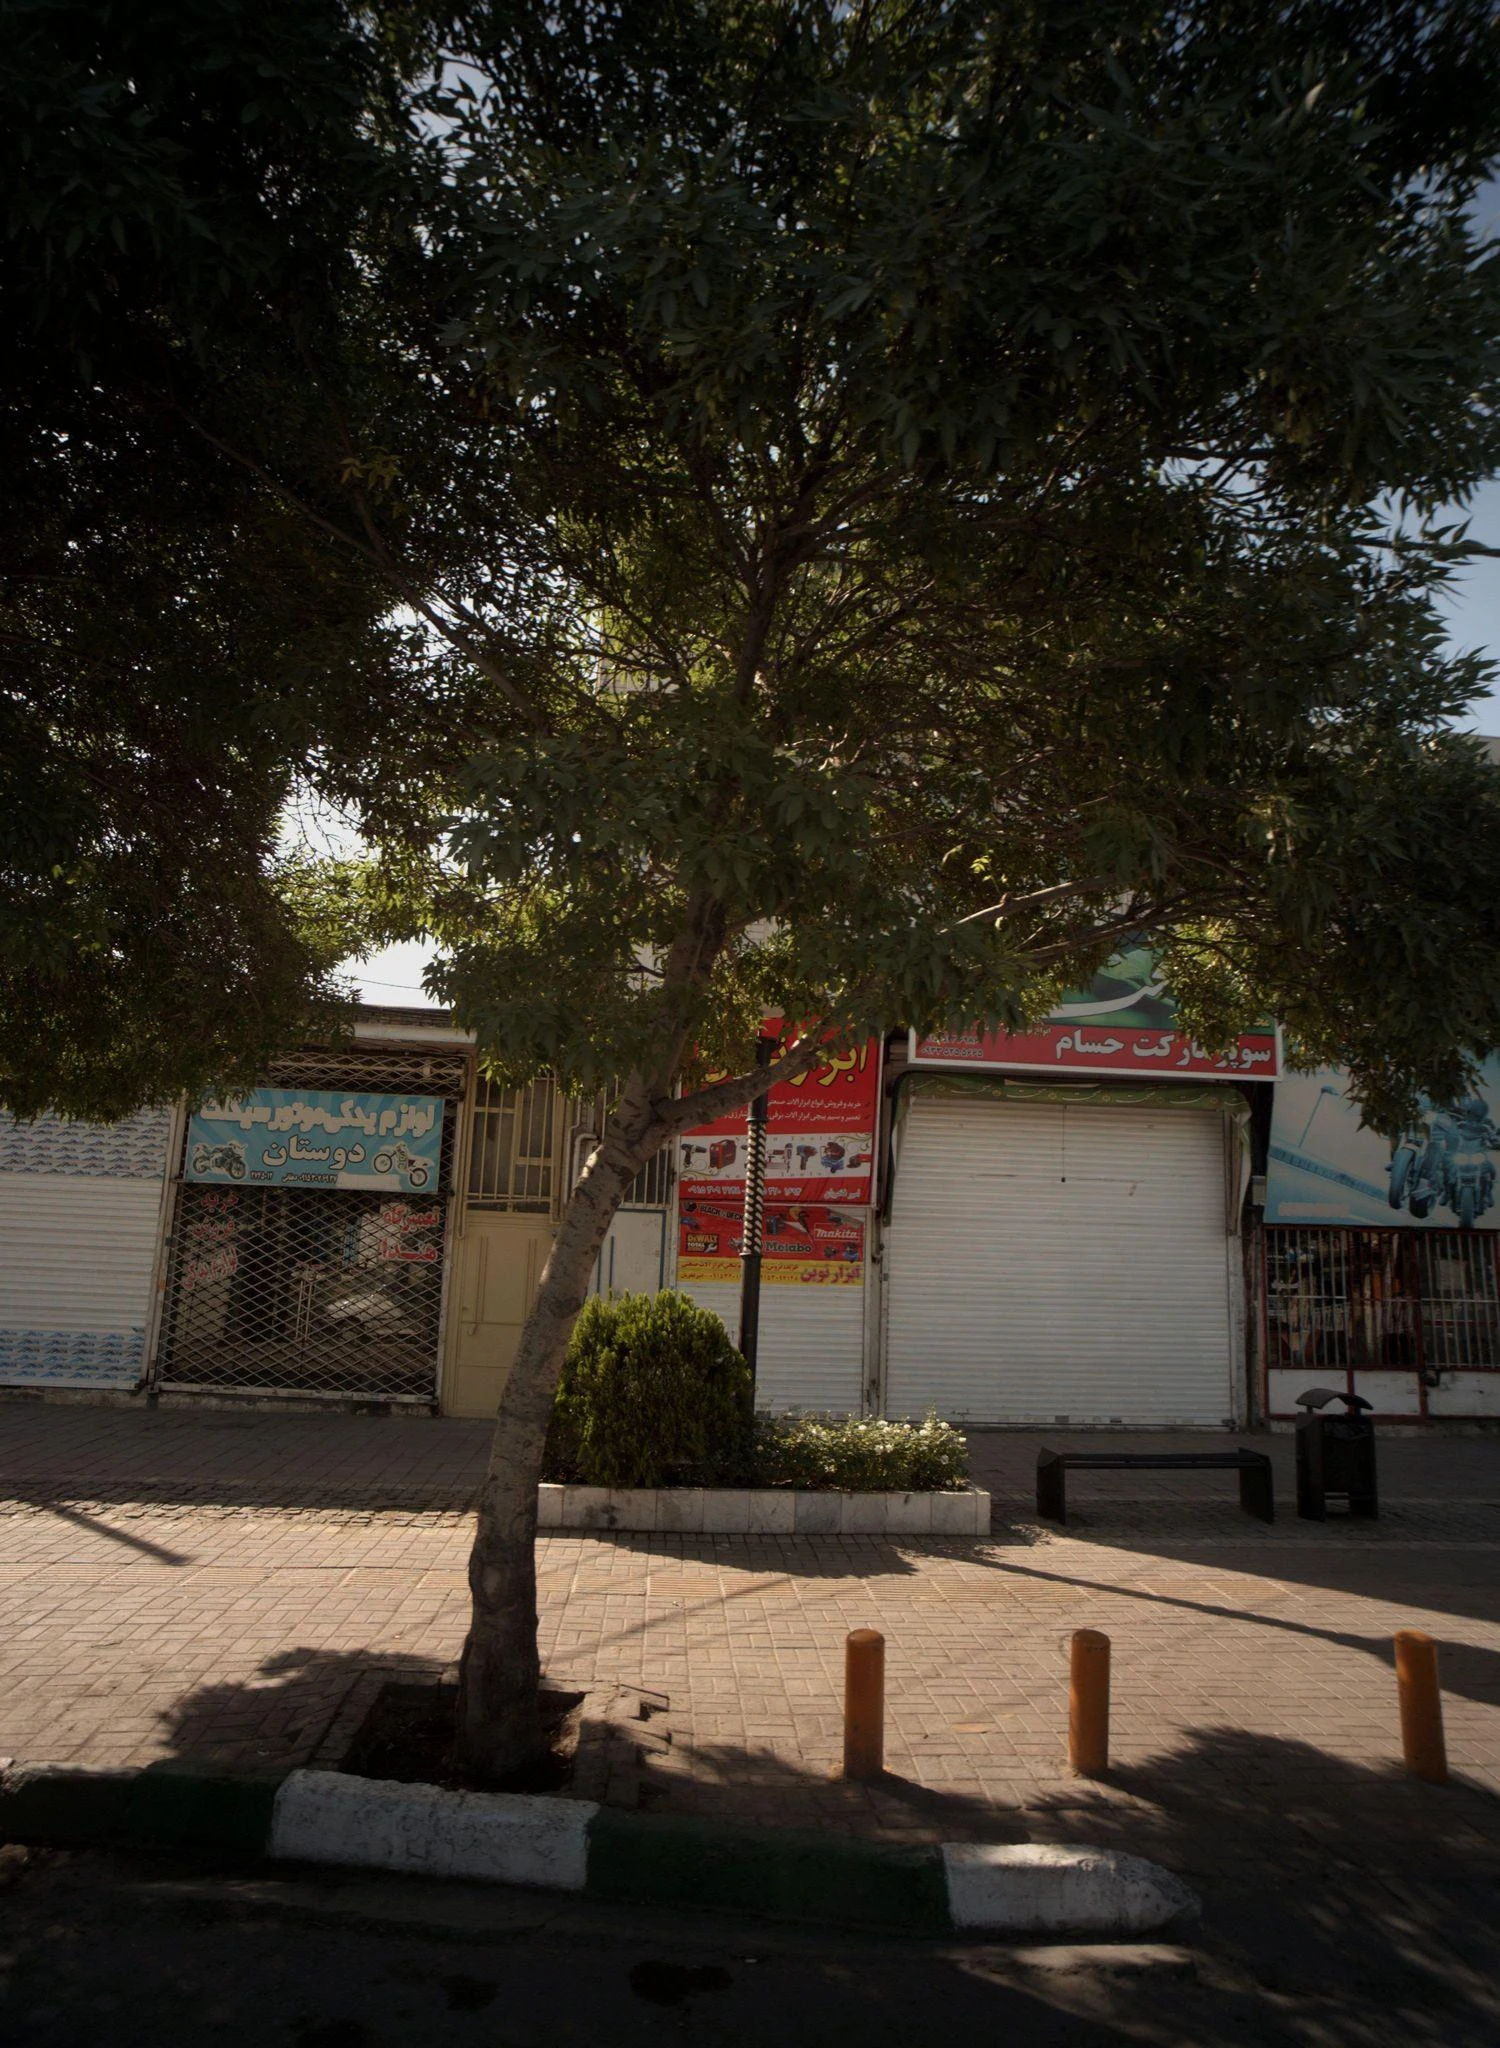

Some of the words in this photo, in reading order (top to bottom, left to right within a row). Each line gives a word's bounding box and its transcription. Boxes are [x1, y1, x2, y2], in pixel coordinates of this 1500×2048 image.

[1055, 1029, 1125, 1060] حسام
[379, 1103, 435, 1138] لوازم
[262, 1134, 367, 1171] دوستان
